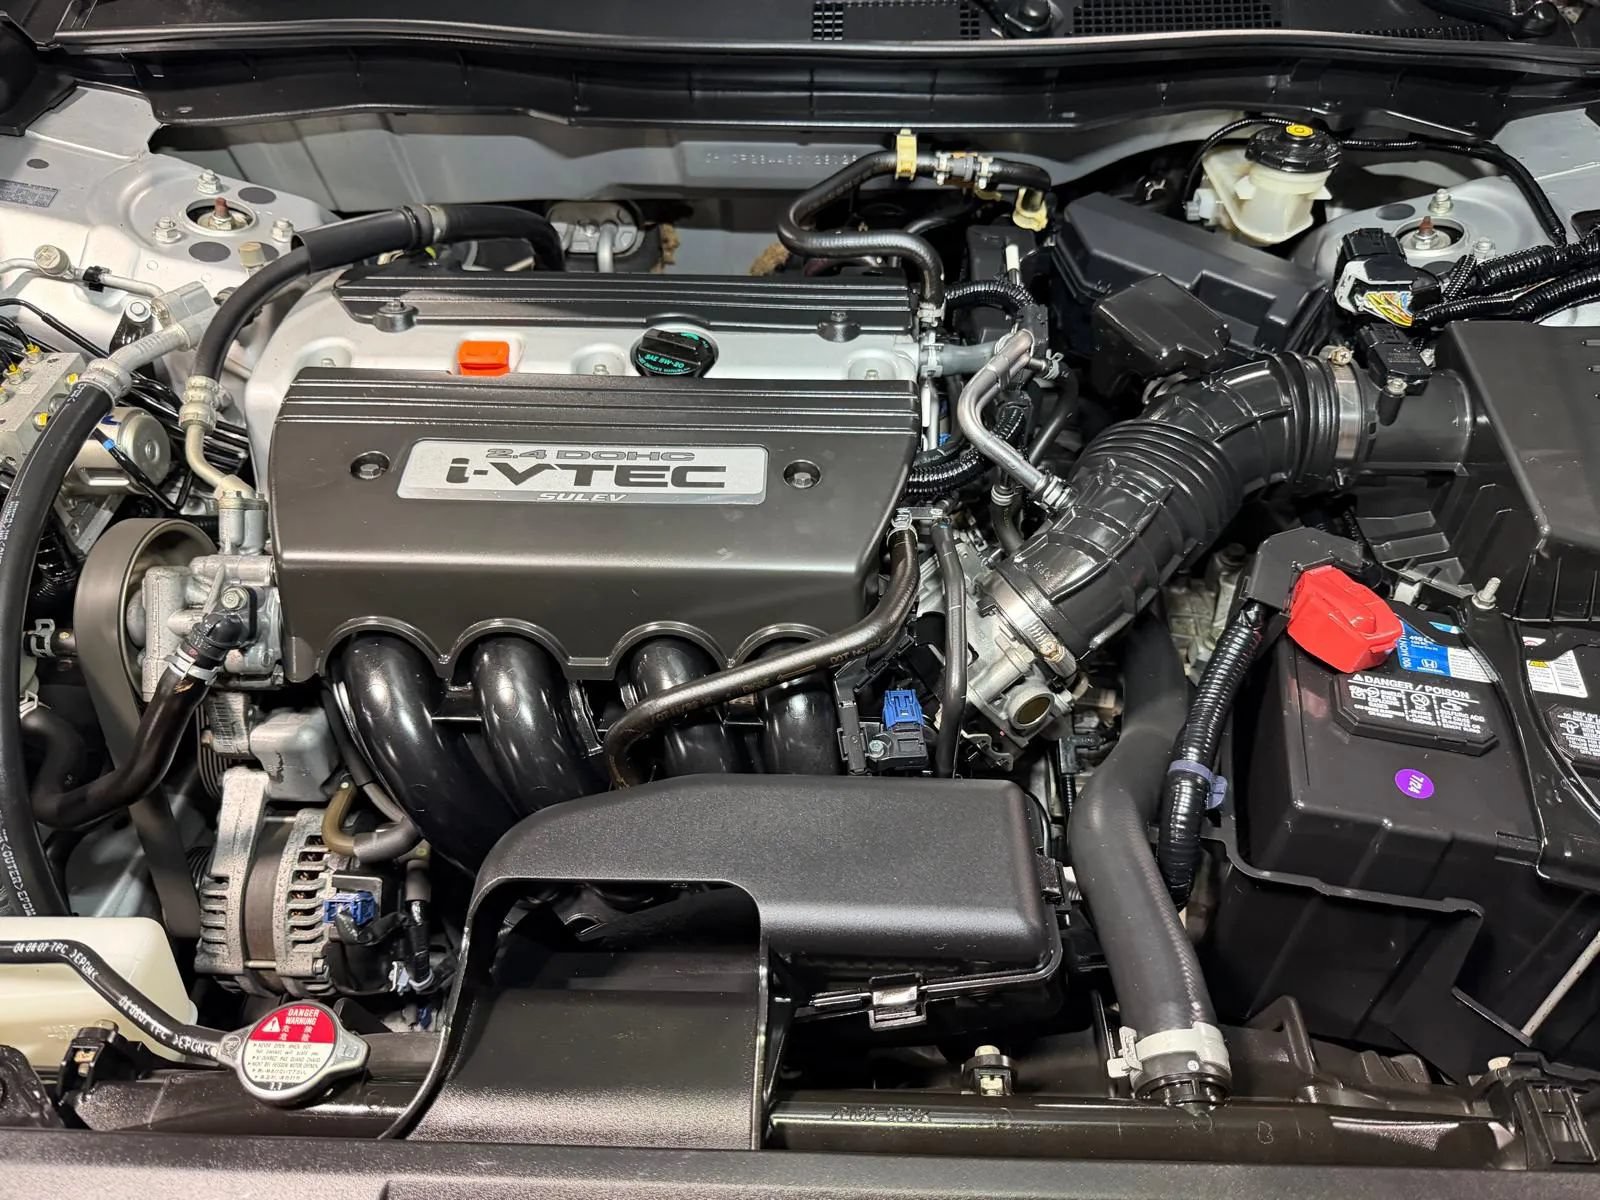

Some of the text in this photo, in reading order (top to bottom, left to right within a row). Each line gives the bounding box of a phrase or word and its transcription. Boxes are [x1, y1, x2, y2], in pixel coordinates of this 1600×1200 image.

[645, 354, 659, 362] SAE
[659, 357, 685, 369] 5W-20
[486, 448, 695, 462] 2.4 DOHC
[446, 458, 727, 488] i-VTEC
[537, 492, 628, 503] SULEV
[1364, 675, 1413, 690] DANGER
[1424, 685, 1470, 699] POISON
[288, 1008, 320, 1017] DANGER
[285, 1016, 317, 1026] WARNUNG
